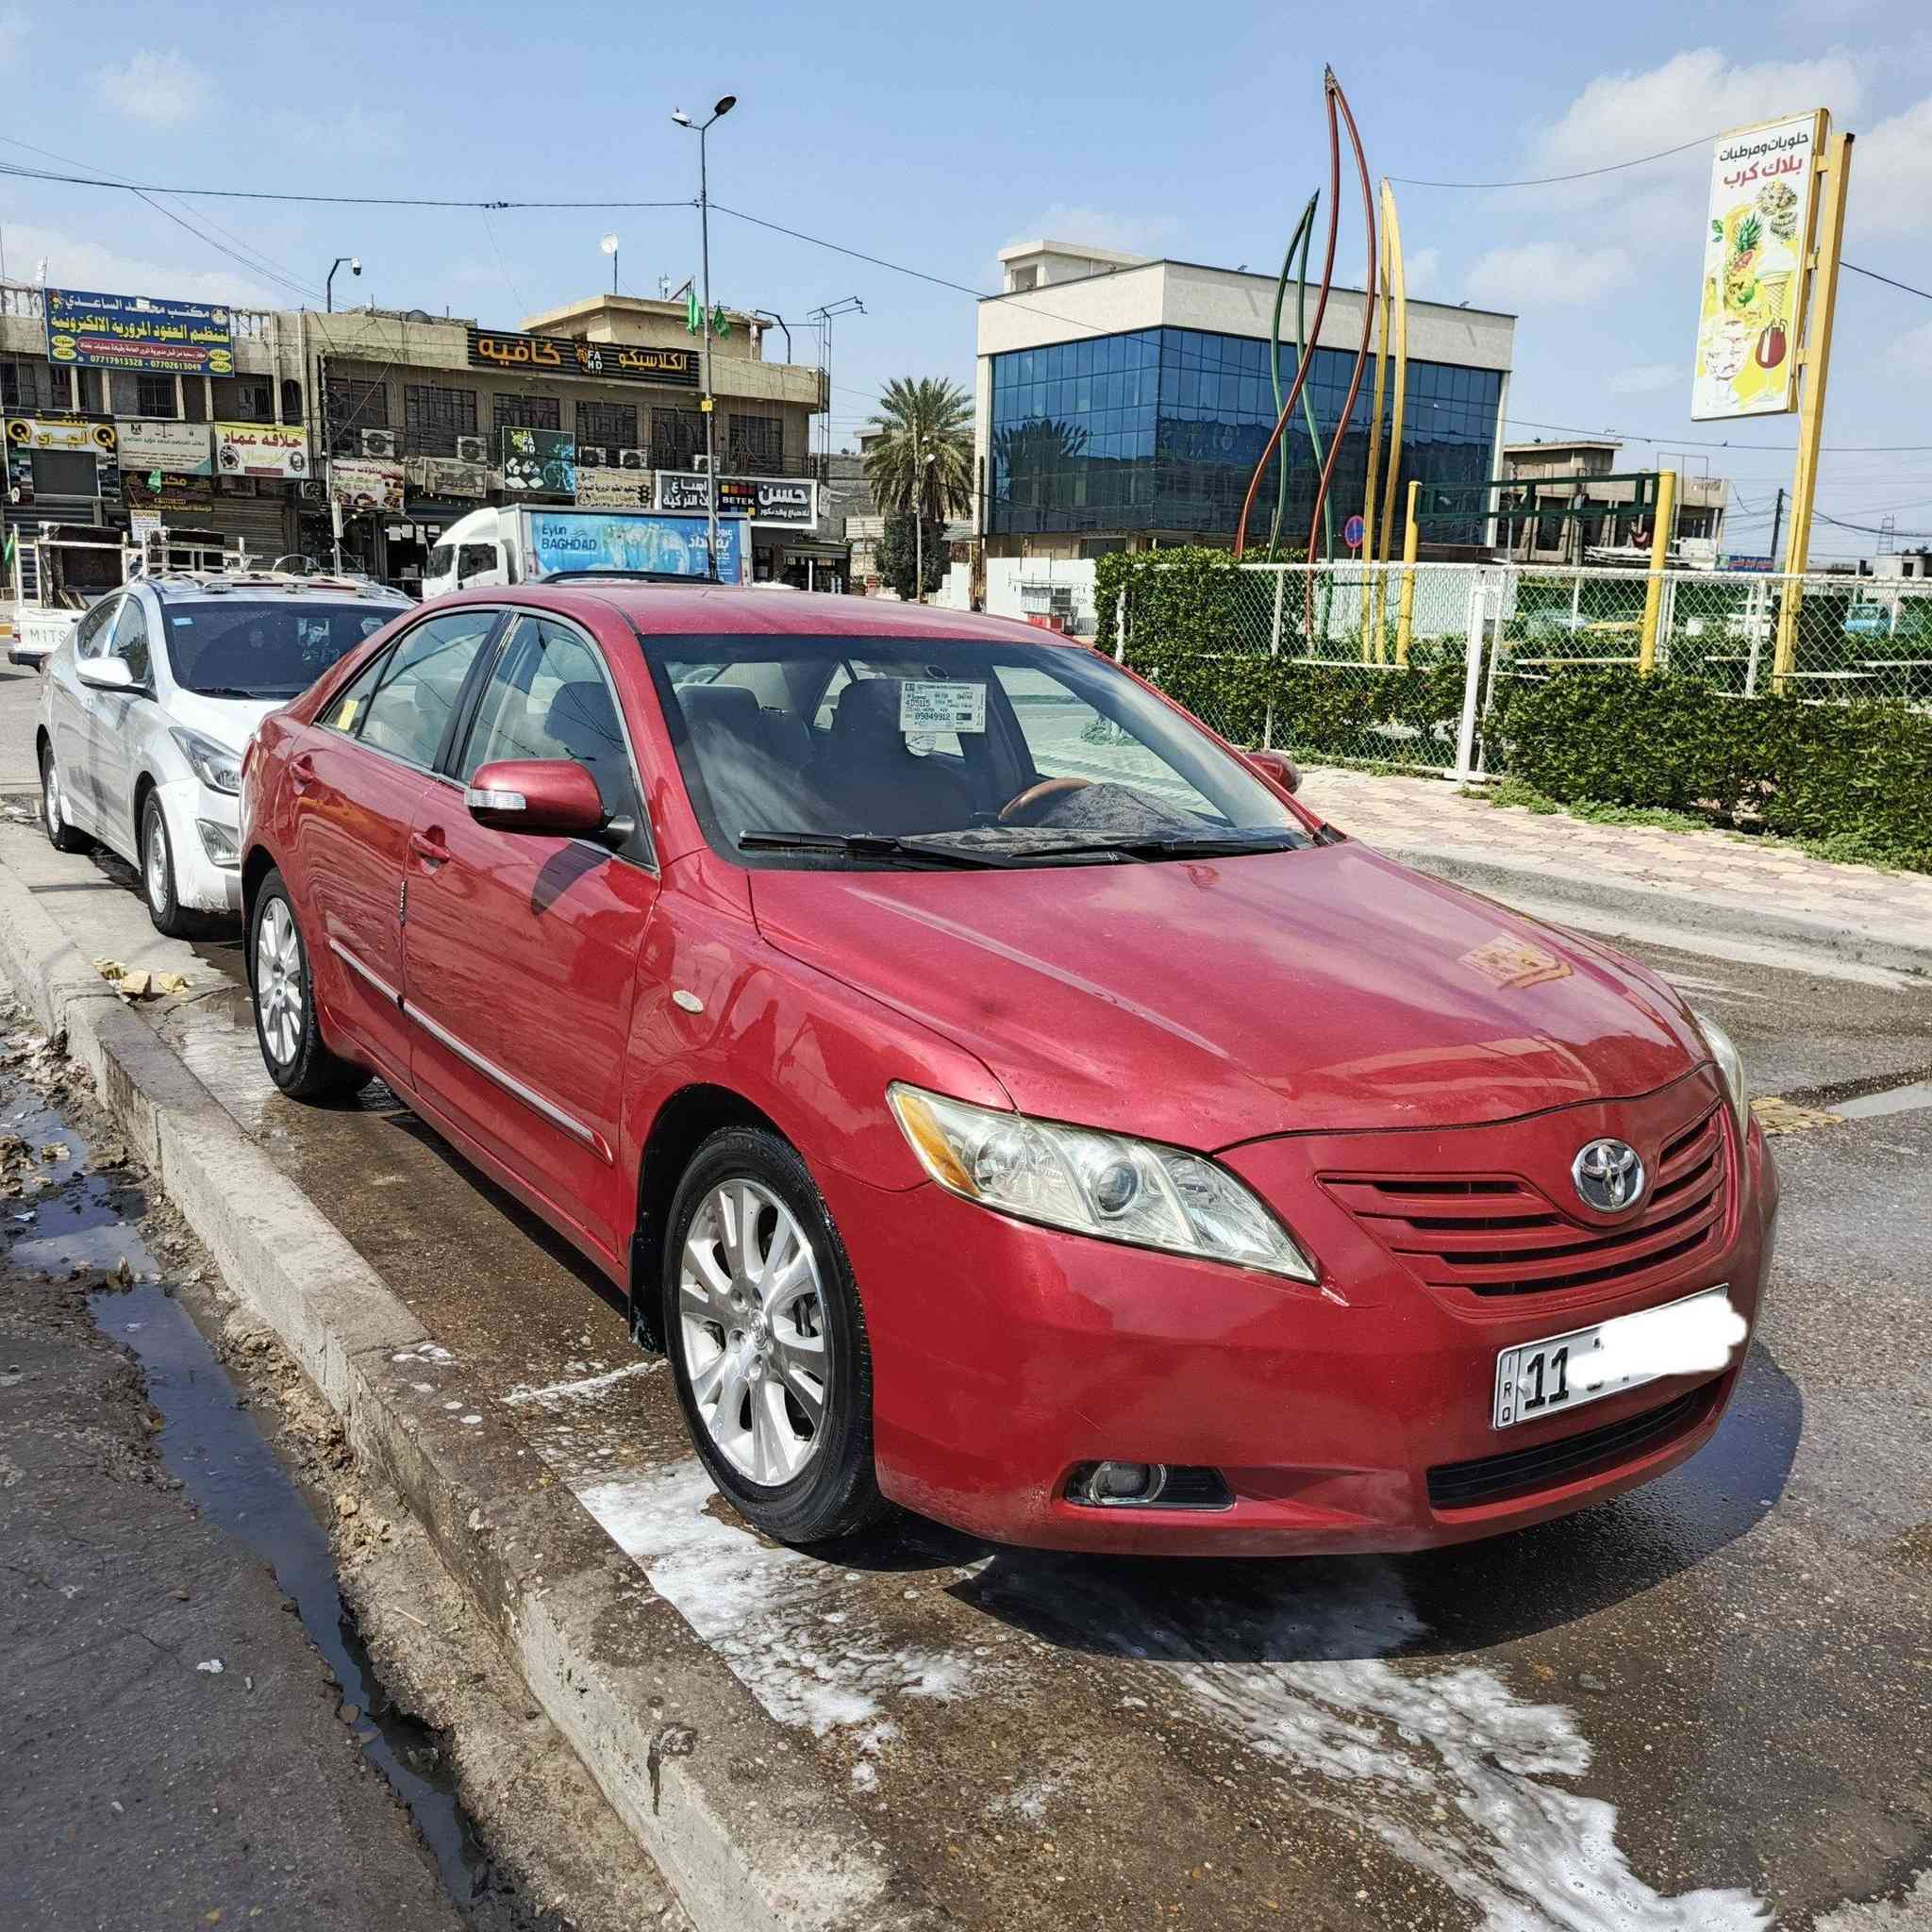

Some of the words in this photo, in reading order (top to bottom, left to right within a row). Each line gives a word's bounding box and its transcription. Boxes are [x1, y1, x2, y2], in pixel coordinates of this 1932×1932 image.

[1768, 132, 1808, 152] حلويات
[1720, 143, 1767, 161] ومرطبات
[1724, 161, 1759, 189] كرب
[1761, 155, 1803, 177] بلاك
[167, 305, 209, 319] مكتب
[111, 317, 151, 339] المرورية
[153, 323, 188, 341] العقود
[190, 325, 229, 344] لتنظيم
[478, 338, 560, 366] كافيه
[588, 351, 602, 360] FA
[619, 348, 688, 370] الكلاسيكو
[588, 360, 603, 370] HD
[224, 430, 257, 446] عماد
[662, 489, 698, 508] التركية
[723, 496, 755, 506] BETEK
[758, 483, 808, 507] حسن
[541, 538, 597, 551] BAGHDAD
[1524, 1346, 1569, 1411] 11
